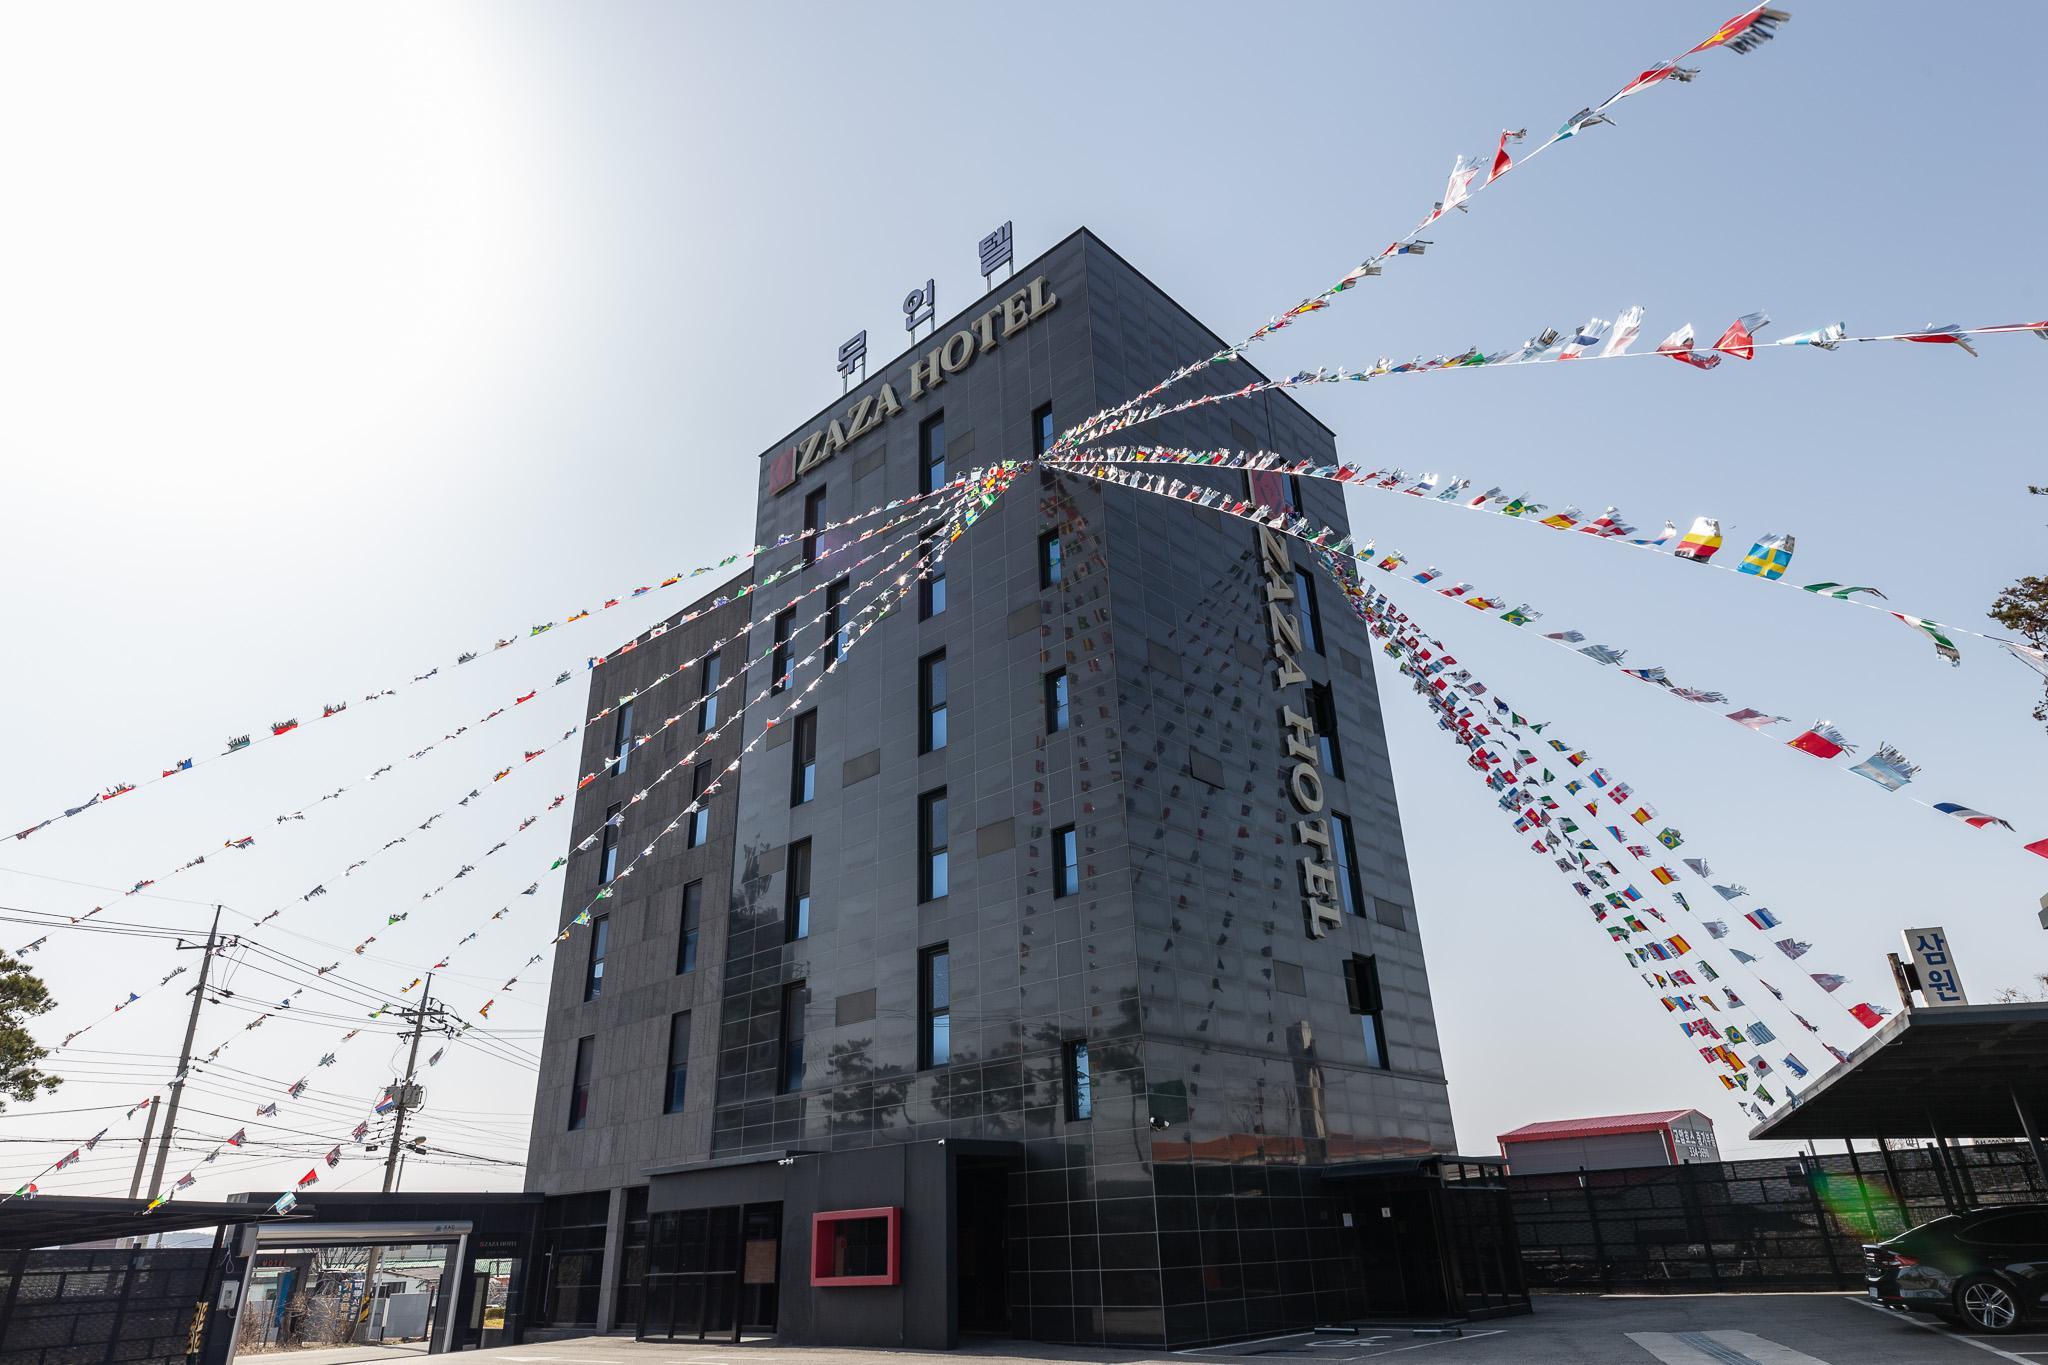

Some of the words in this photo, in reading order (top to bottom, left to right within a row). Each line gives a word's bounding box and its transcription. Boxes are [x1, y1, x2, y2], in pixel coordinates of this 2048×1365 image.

[797, 383, 902, 474] ZAZA
[908, 276, 1057, 400] HOTEL
[1259, 524, 1306, 688] ZAZA
[1283, 705, 1341, 940] HOTEL
[1916, 933, 1960, 1002] 삼원
